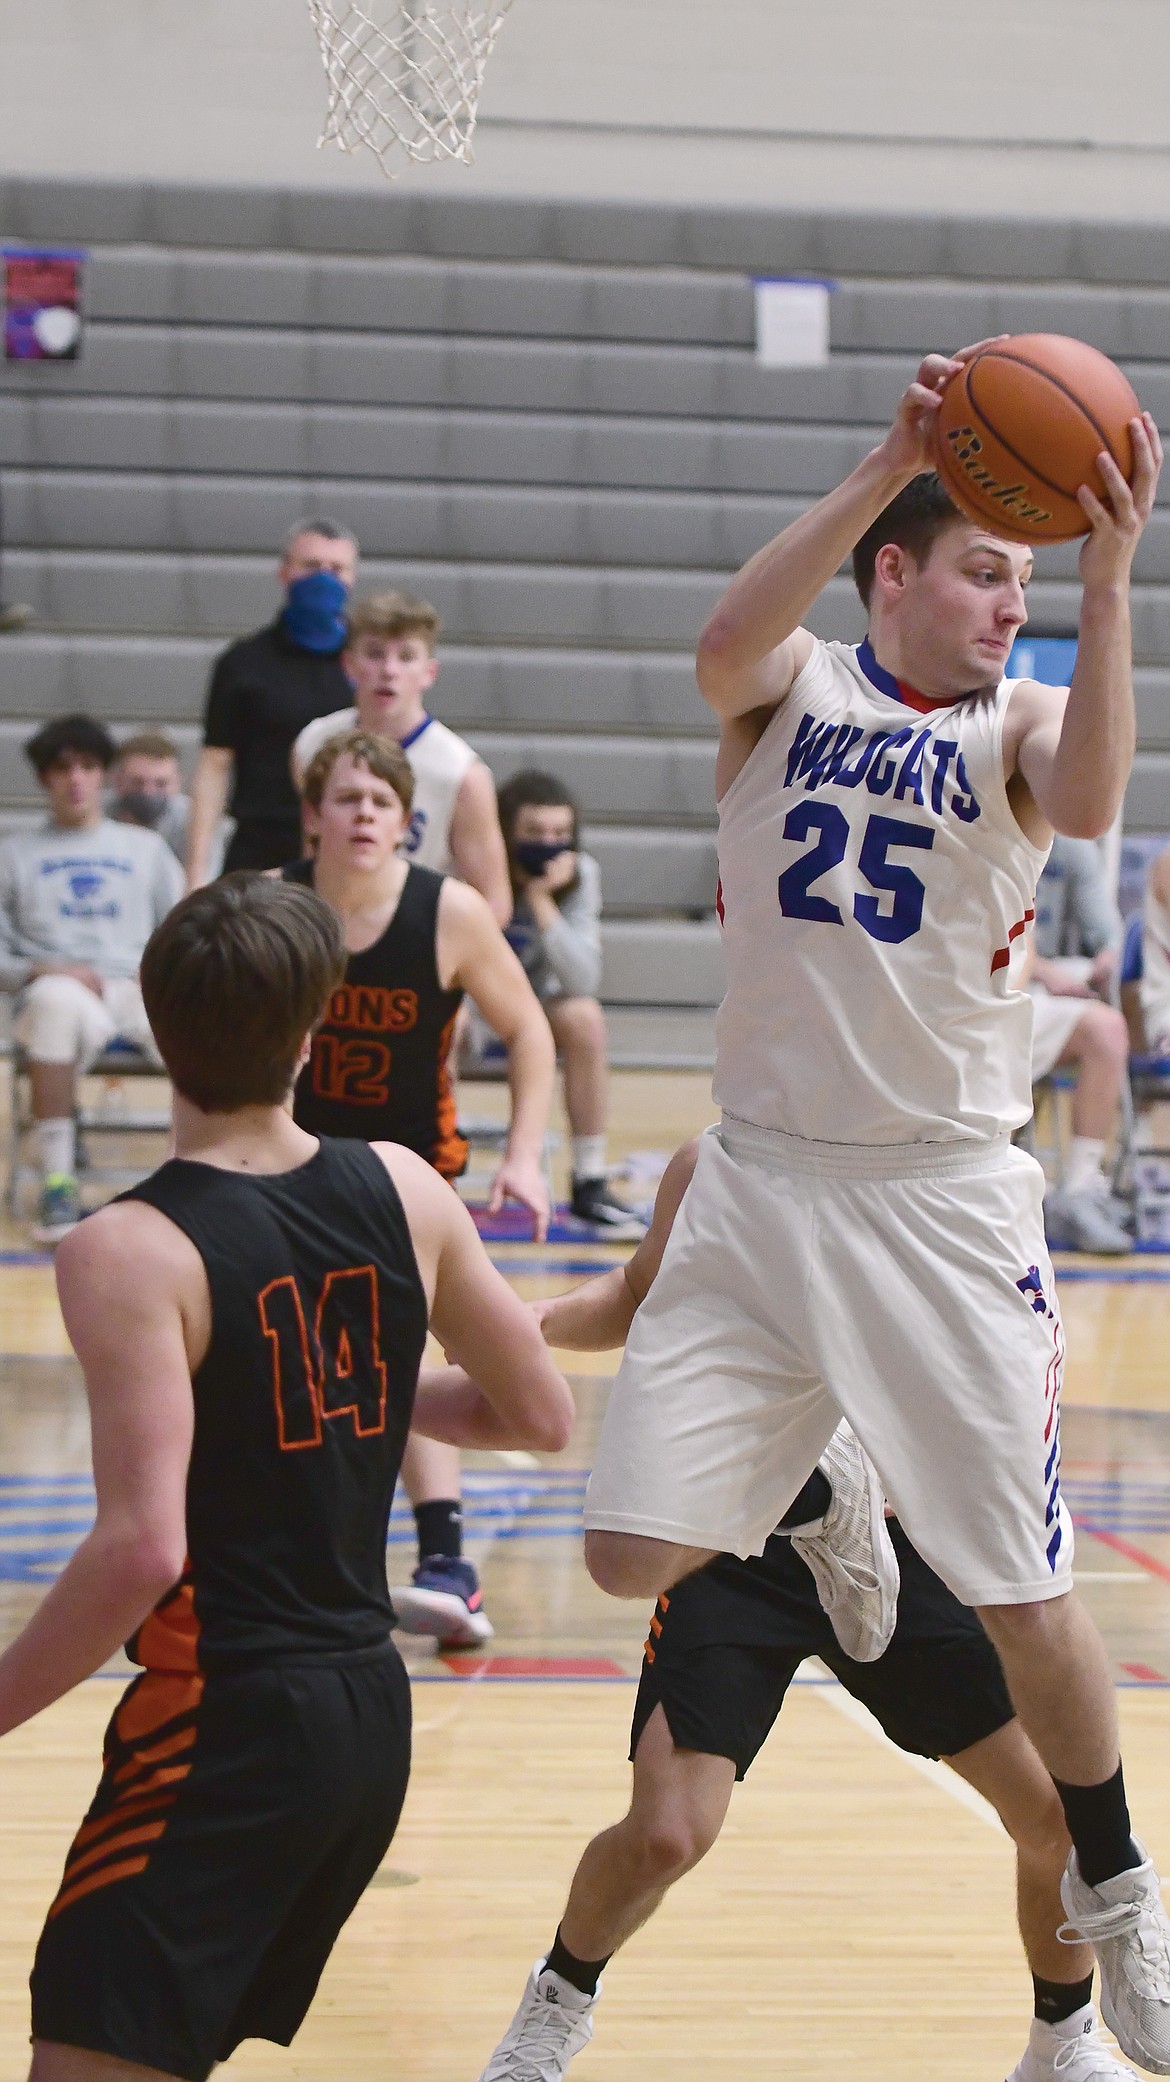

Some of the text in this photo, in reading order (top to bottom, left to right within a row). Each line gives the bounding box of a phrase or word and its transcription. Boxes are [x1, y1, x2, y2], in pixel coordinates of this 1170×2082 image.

[945, 424, 1053, 524] Baden
[783, 712, 982, 824] WILDCATS
[778, 799, 936, 944] 25
[322, 984, 419, 1033] ONS
[313, 1034, 391, 1105] 12
[257, 1264, 387, 1451] 14
